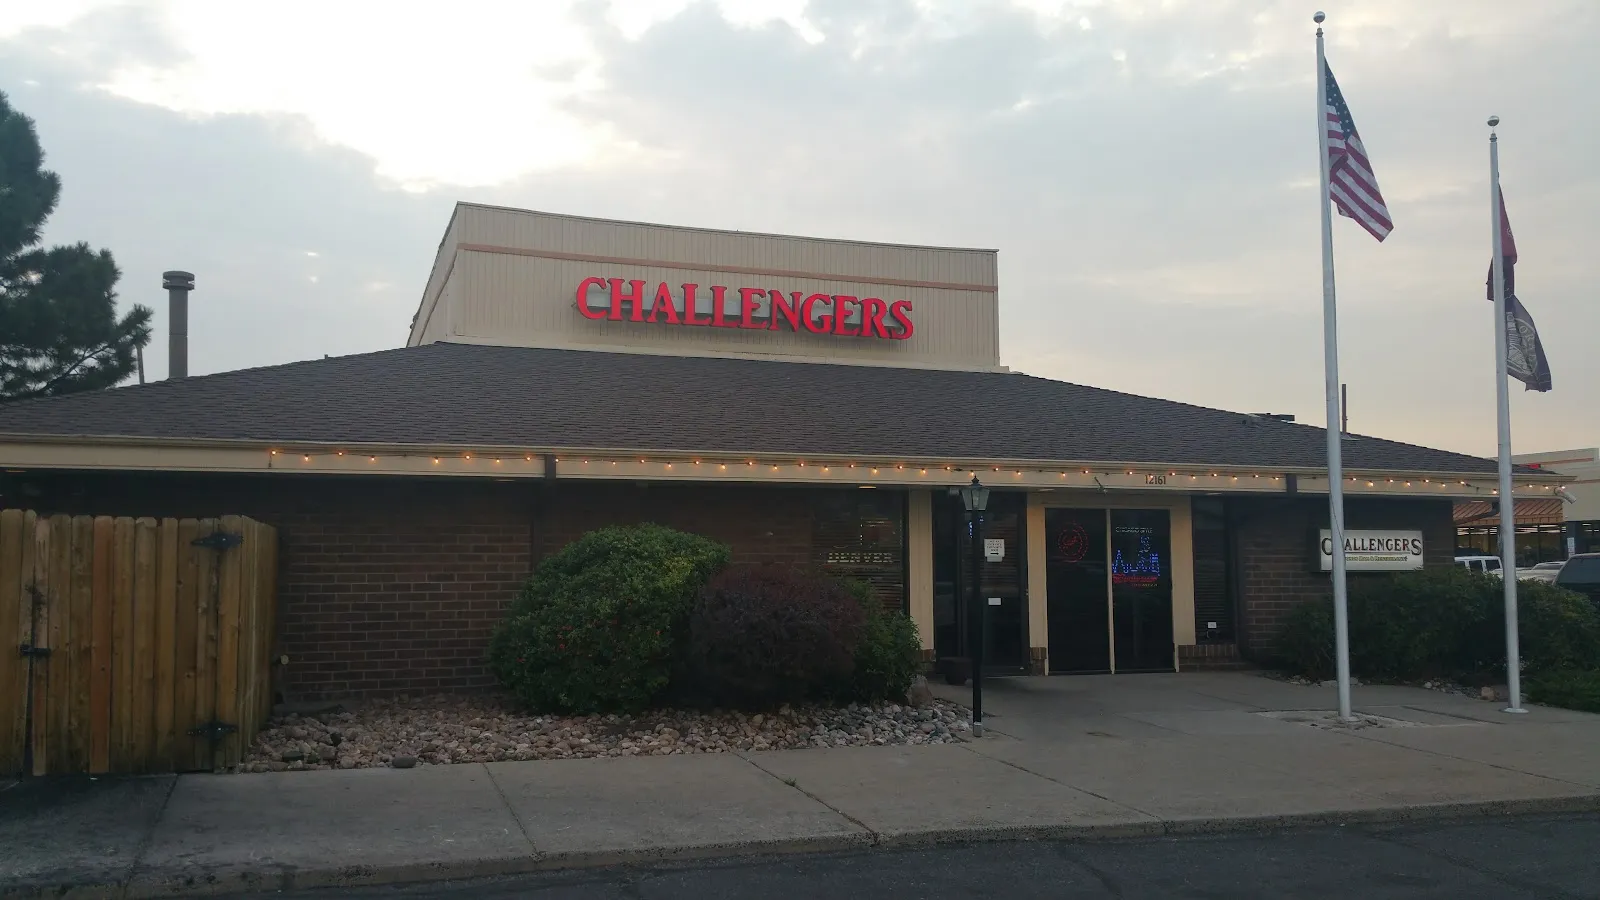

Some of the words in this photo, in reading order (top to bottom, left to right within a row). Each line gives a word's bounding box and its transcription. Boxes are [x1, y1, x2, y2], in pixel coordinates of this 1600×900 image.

[574, 276, 914, 340] CHALLENGERS
[1144, 474, 1166, 485] 12161
[1321, 538, 1422, 555] CALLENGERS
